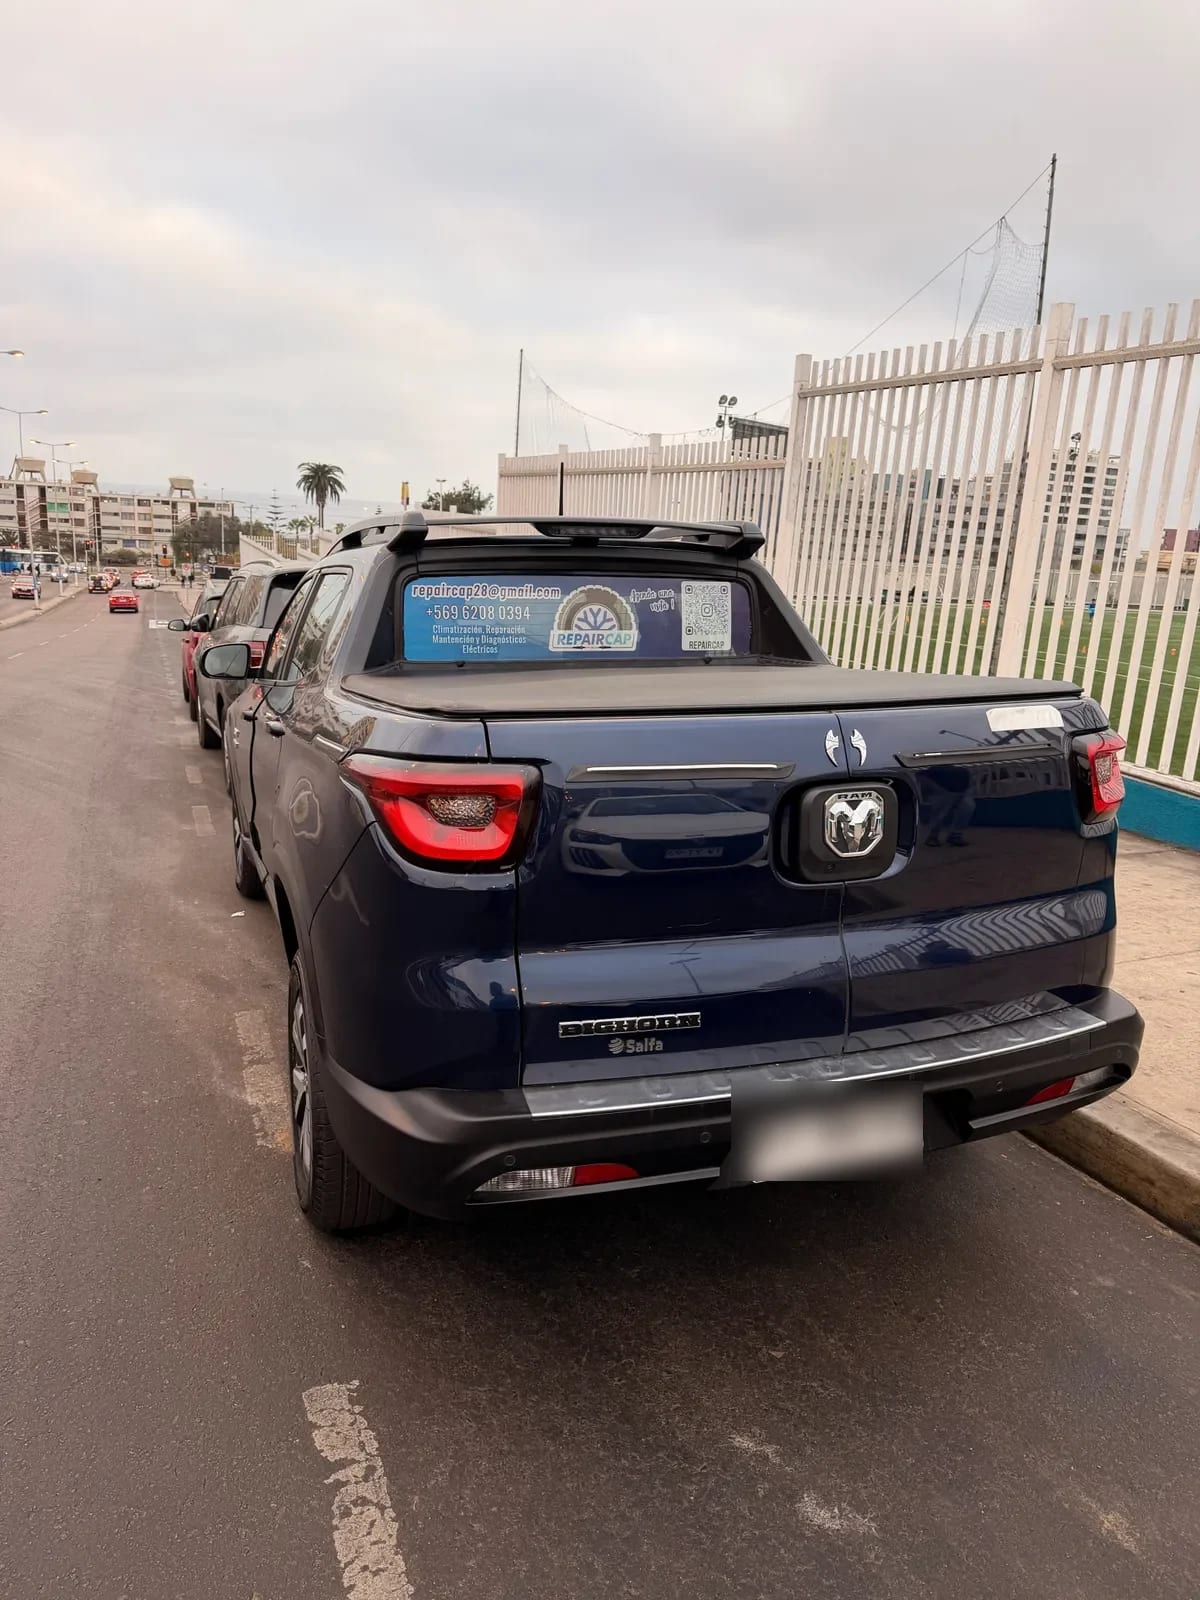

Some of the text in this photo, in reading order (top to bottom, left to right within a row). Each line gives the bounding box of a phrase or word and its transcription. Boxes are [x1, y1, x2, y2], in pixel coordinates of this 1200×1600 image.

[412, 583, 560, 600] repaircap28@gmail.com
[426, 605, 530, 620] +569 6208 0394
[486, 625, 526, 635] Reparación
[432, 635, 475, 643] Mantención
[481, 636, 526, 644] Diagnósticos
[558, 633, 631, 645] REPAIRCAP
[462, 645, 498, 653] Eléctricos
[689, 641, 724, 649] REPAIRCAP
[838, 792, 873, 800] RAM
[559, 1012, 701, 1038] BIGHORN
[625, 1037, 664, 1053] Salfa
